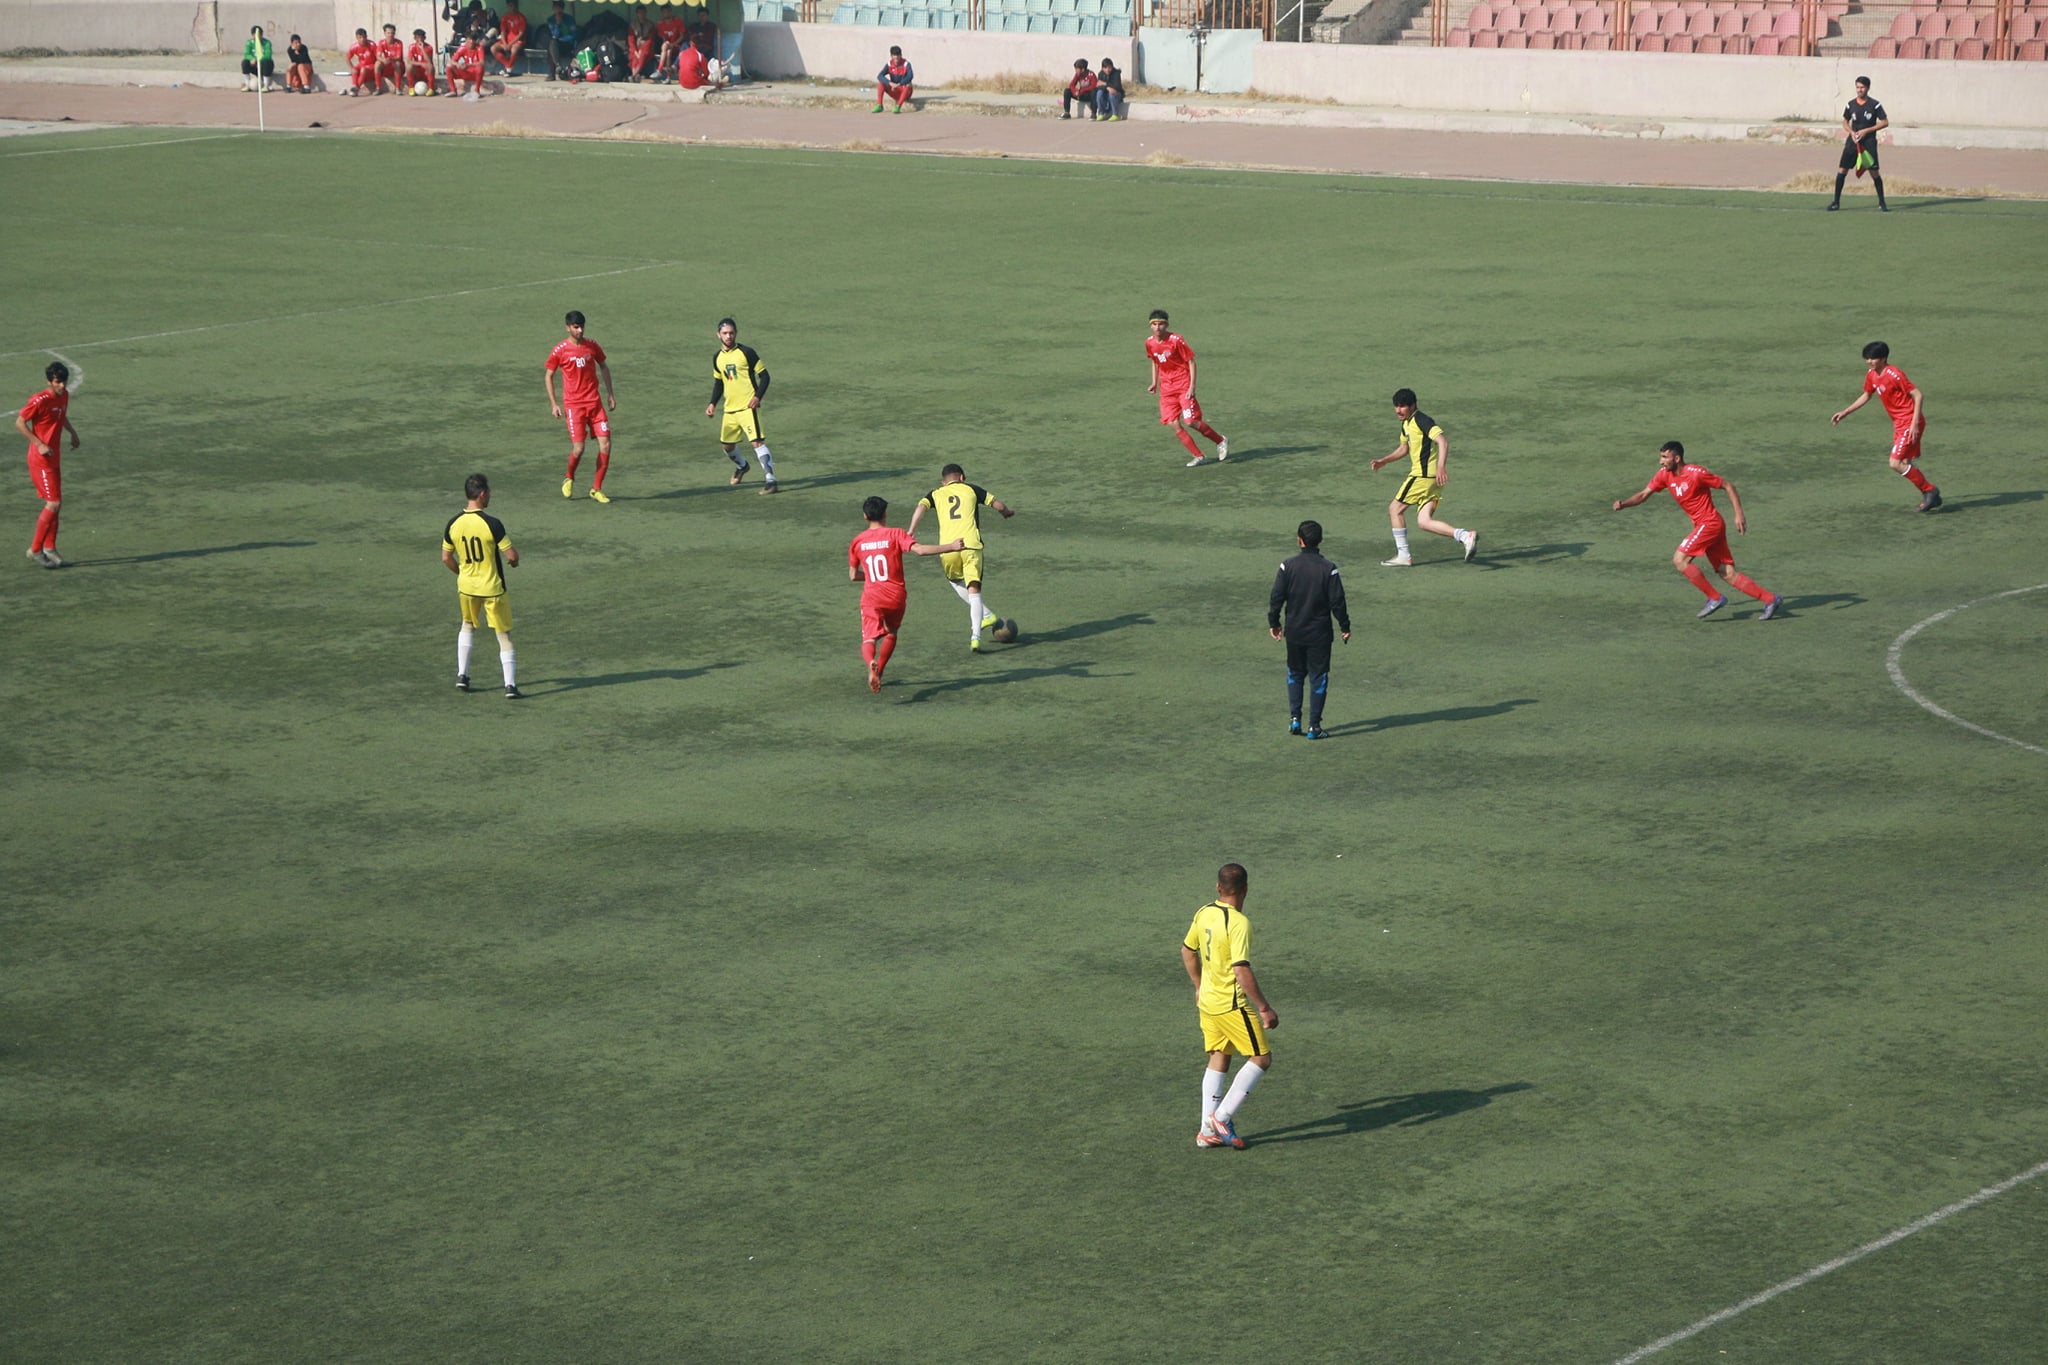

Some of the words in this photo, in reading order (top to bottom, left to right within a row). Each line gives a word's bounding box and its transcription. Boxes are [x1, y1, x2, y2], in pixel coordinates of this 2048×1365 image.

[948, 495, 962, 520] 2
[462, 535, 485, 564] 10
[865, 554, 889, 583] 10
